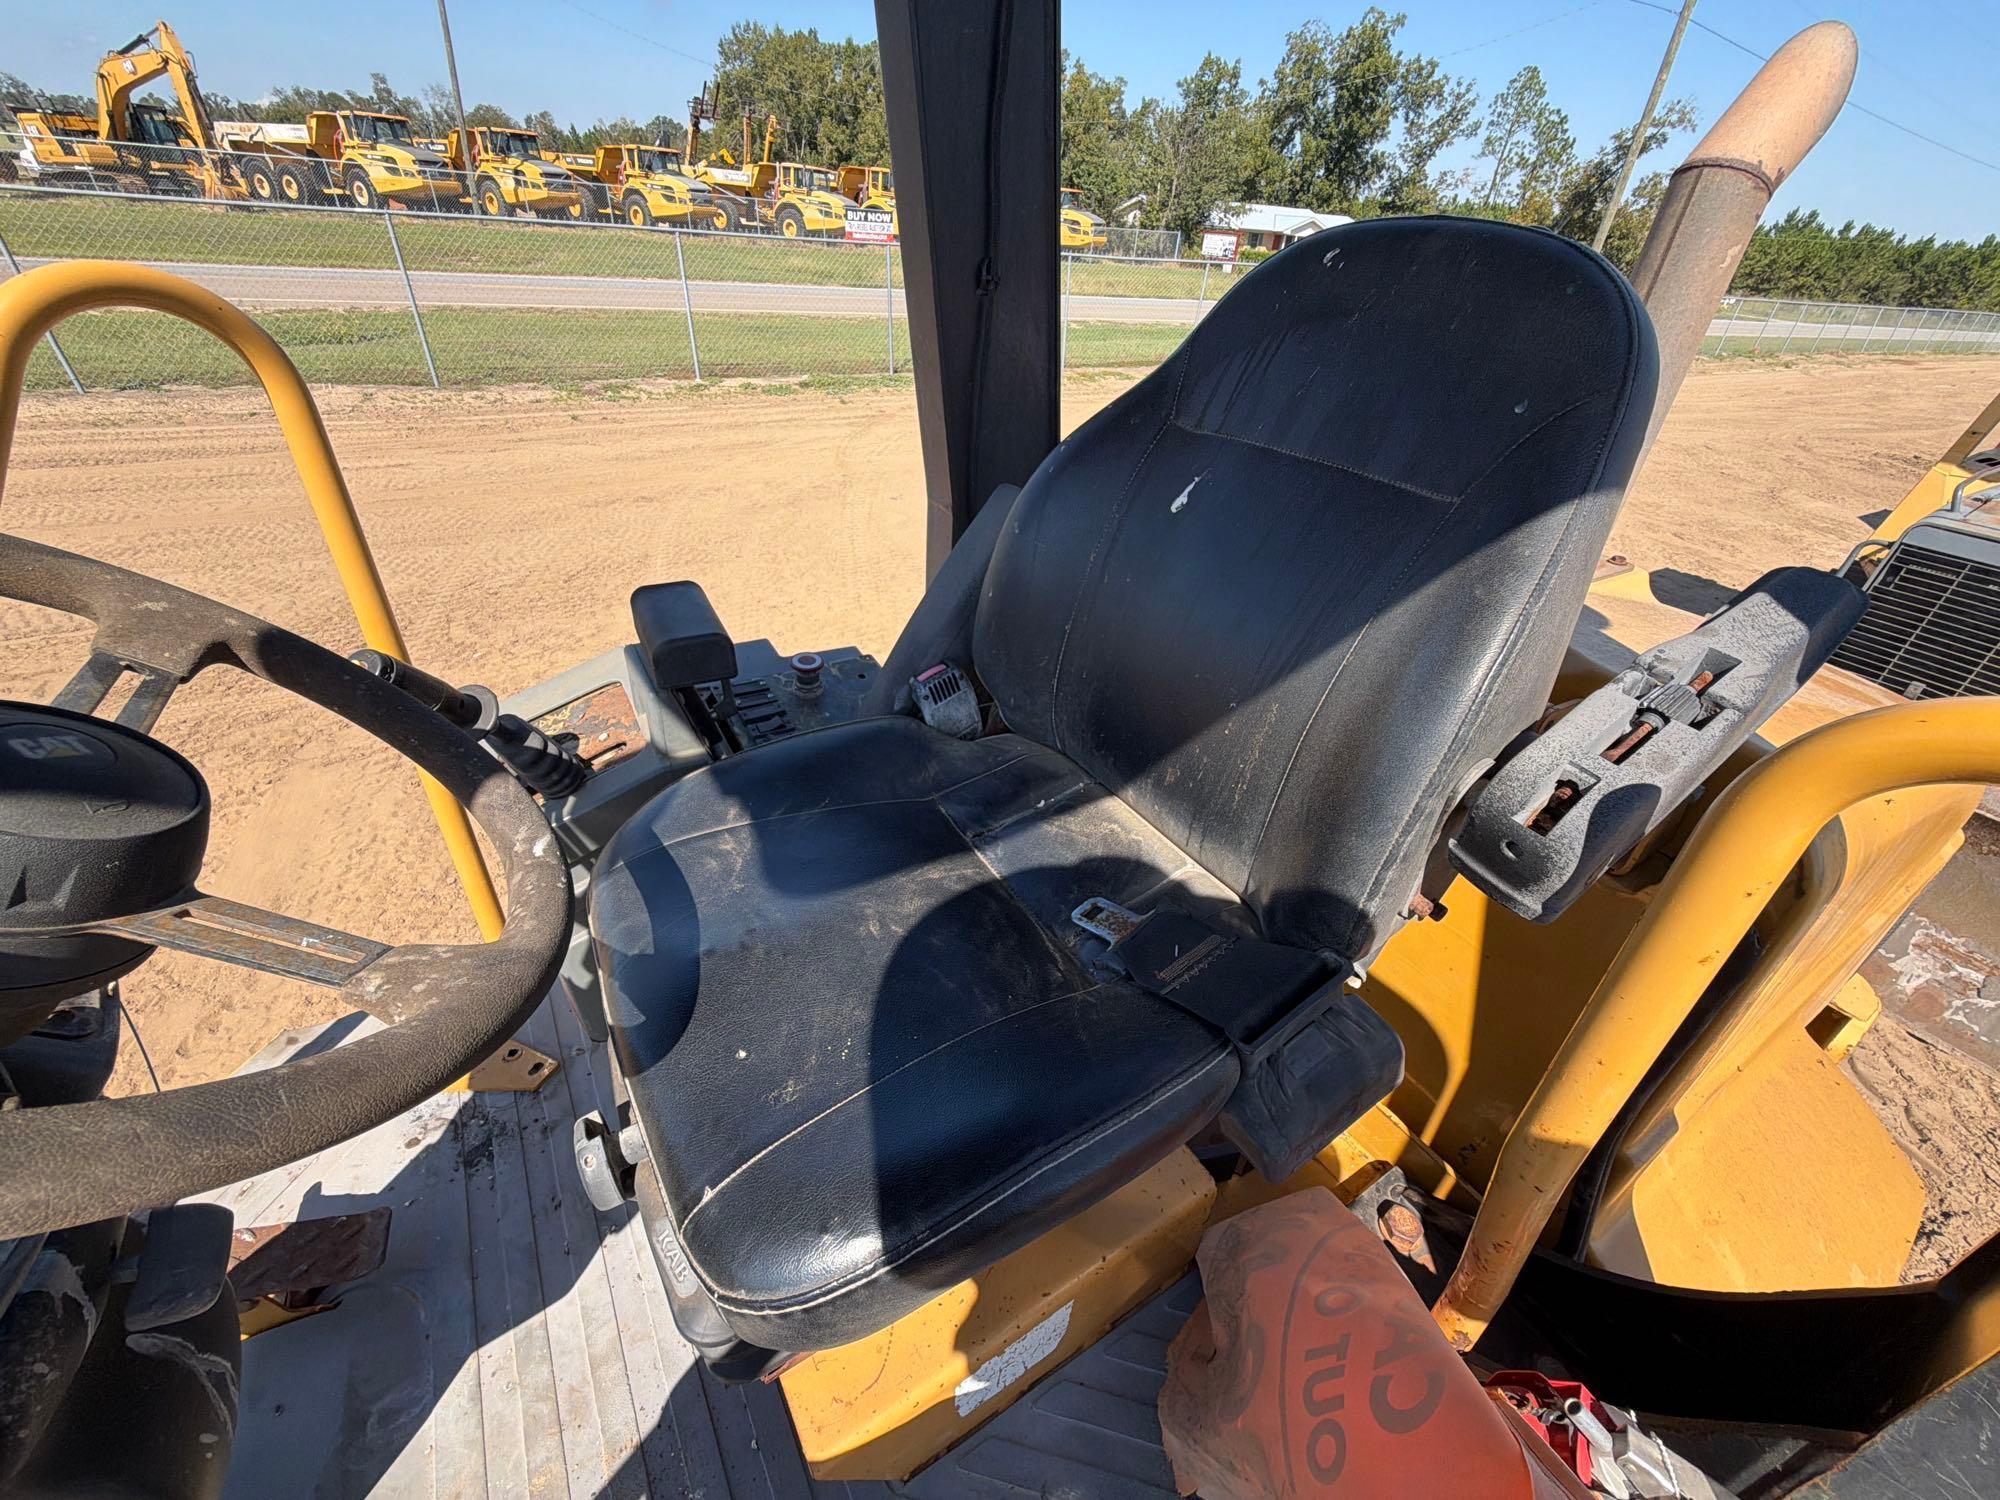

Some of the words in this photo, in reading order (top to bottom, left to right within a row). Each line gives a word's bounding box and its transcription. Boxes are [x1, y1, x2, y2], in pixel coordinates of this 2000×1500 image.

[847, 210, 866, 221] BUY
[867, 212, 892, 223] NOW
[7, 735, 95, 760] CAT
[657, 1228, 690, 1282] KAB
